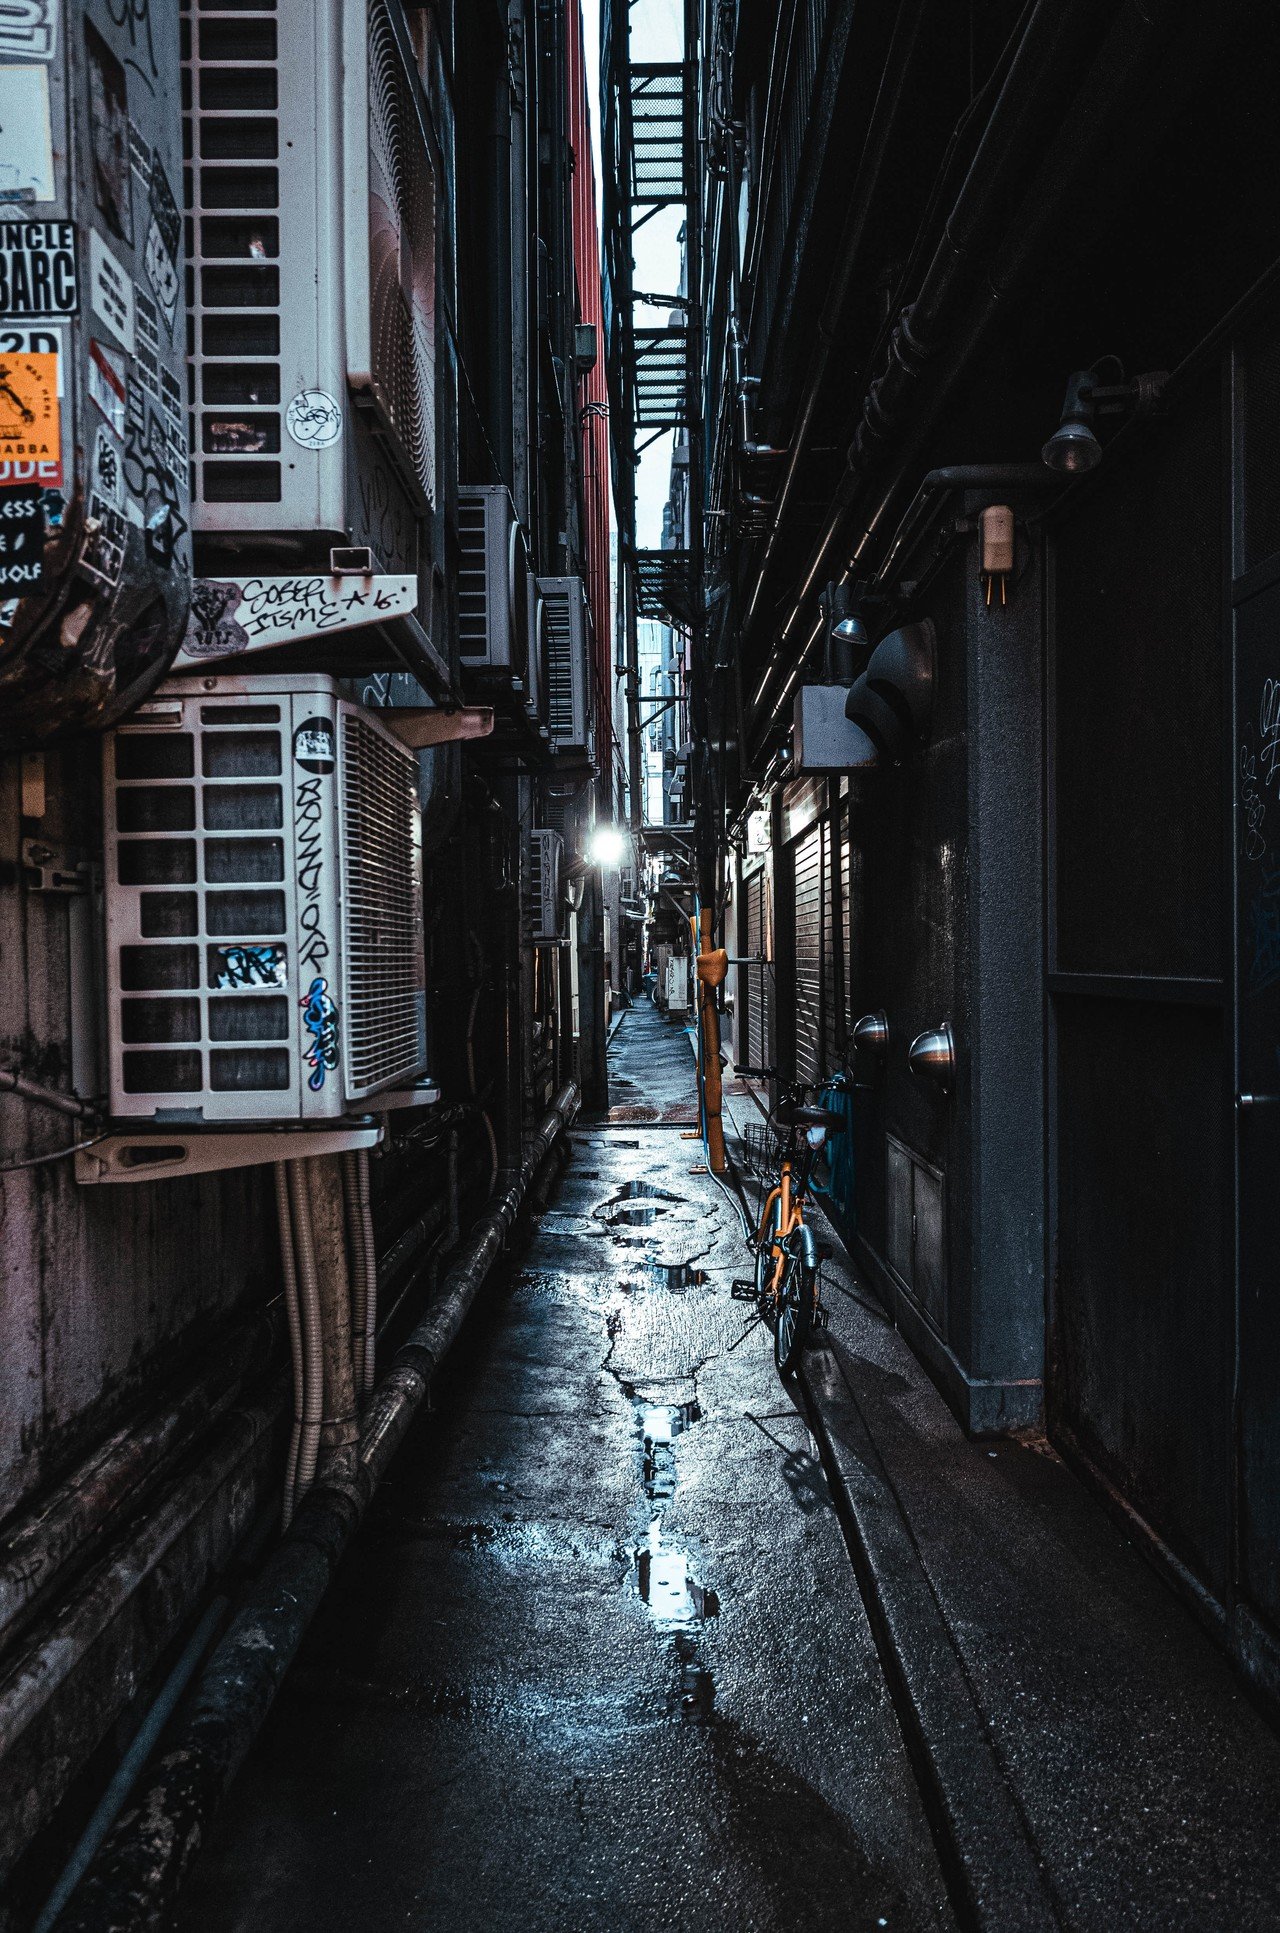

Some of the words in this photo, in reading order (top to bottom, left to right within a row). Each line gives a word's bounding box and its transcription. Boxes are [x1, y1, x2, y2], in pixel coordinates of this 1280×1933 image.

[0, 225, 72, 250] NCLE
[0, 444, 49, 455] ABBA
[0, 500, 36, 518] ESS
